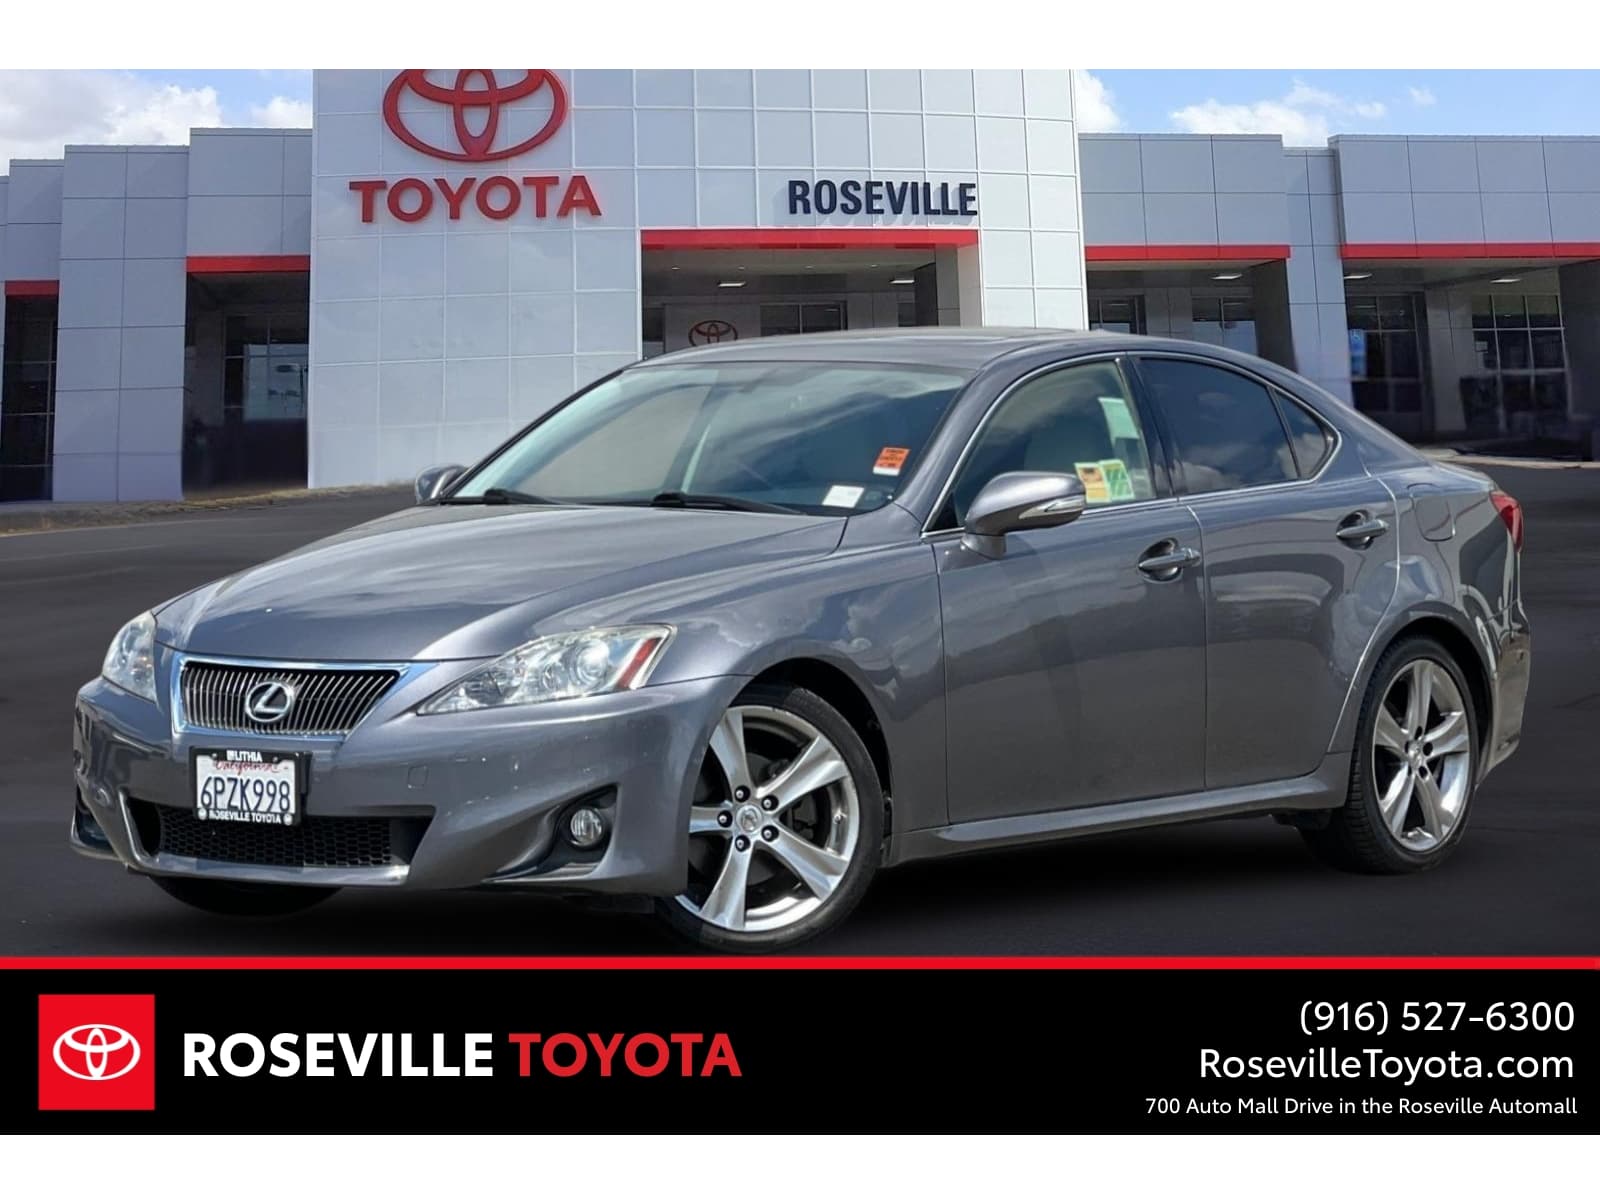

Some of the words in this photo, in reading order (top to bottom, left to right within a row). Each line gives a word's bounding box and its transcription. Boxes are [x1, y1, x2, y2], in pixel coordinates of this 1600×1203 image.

[349, 175, 602, 223] TOYOTA
[788, 179, 979, 217] ROSEVILLE
[200, 776, 291, 813] 6PZK998
[208, 809, 251, 822] ROSEVILLE
[251, 812, 282, 825] TOYOTA
